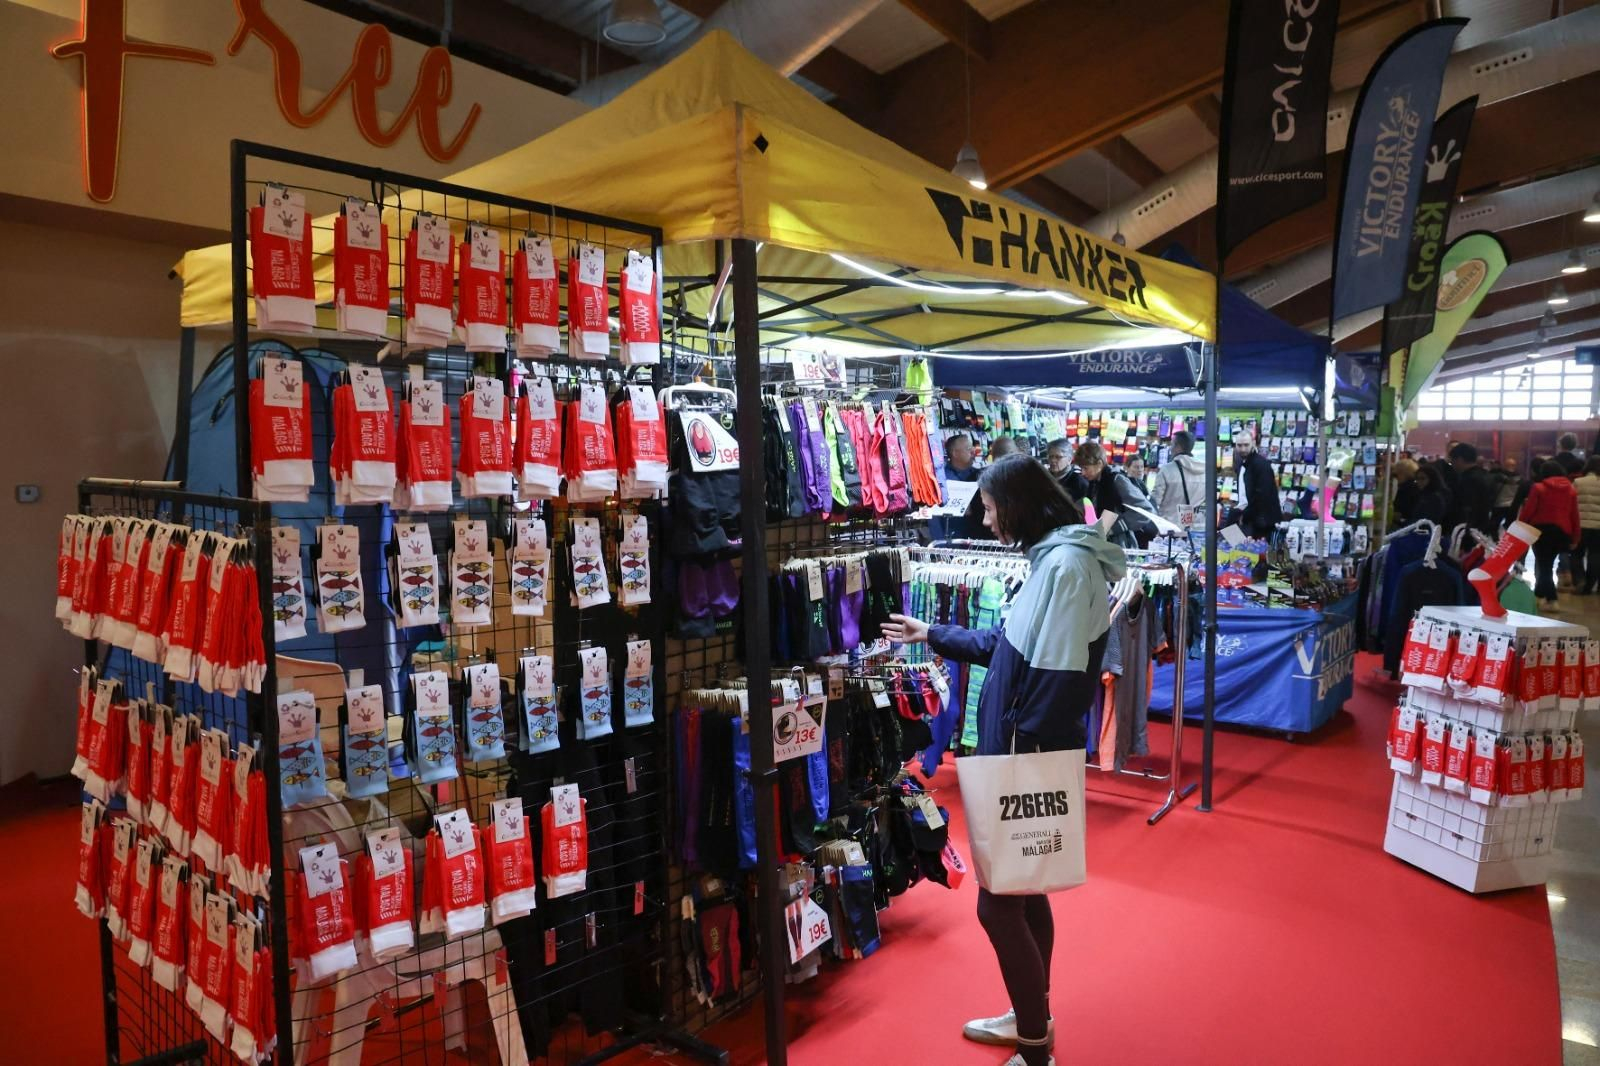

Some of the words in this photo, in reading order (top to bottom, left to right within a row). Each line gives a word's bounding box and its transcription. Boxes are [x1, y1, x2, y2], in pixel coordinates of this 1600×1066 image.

[1384, 113, 1420, 239] ENDURANCE
[1357, 122, 1400, 258] VICTORY
[1069, 350, 1147, 363] VICTORY
[1080, 363, 1154, 374] ENDURANCE
[795, 727, 816, 745] 13€
[1000, 790, 1069, 821] 226ERS
[1020, 830, 1051, 840] GENERALI
[808, 918, 828, 944] 19€
